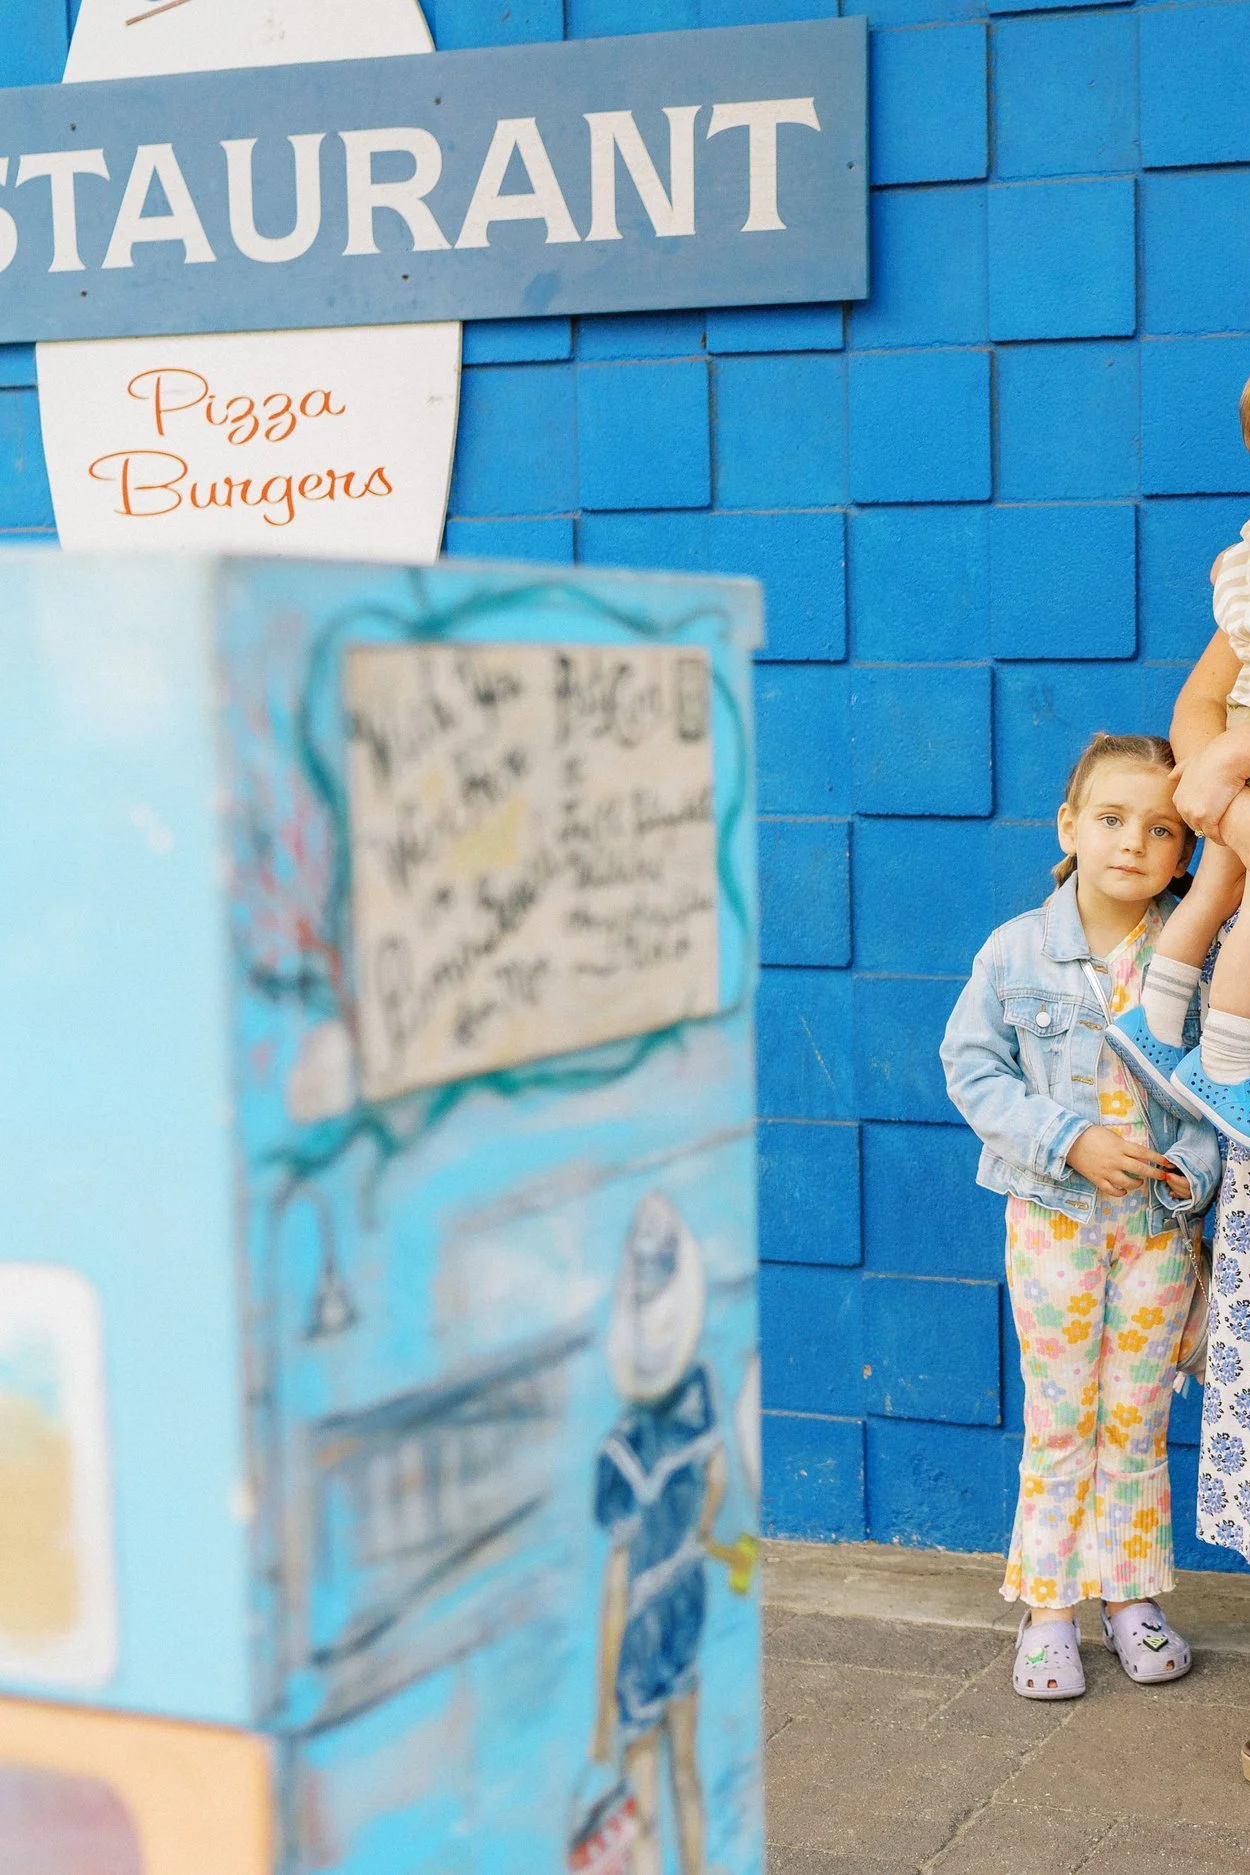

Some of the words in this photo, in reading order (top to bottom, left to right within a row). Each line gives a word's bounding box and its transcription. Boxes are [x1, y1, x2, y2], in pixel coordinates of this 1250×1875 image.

[0, 97, 822, 273] TAURANT
[127, 368, 346, 445] Pizza
[88, 450, 393, 526] Burgers
